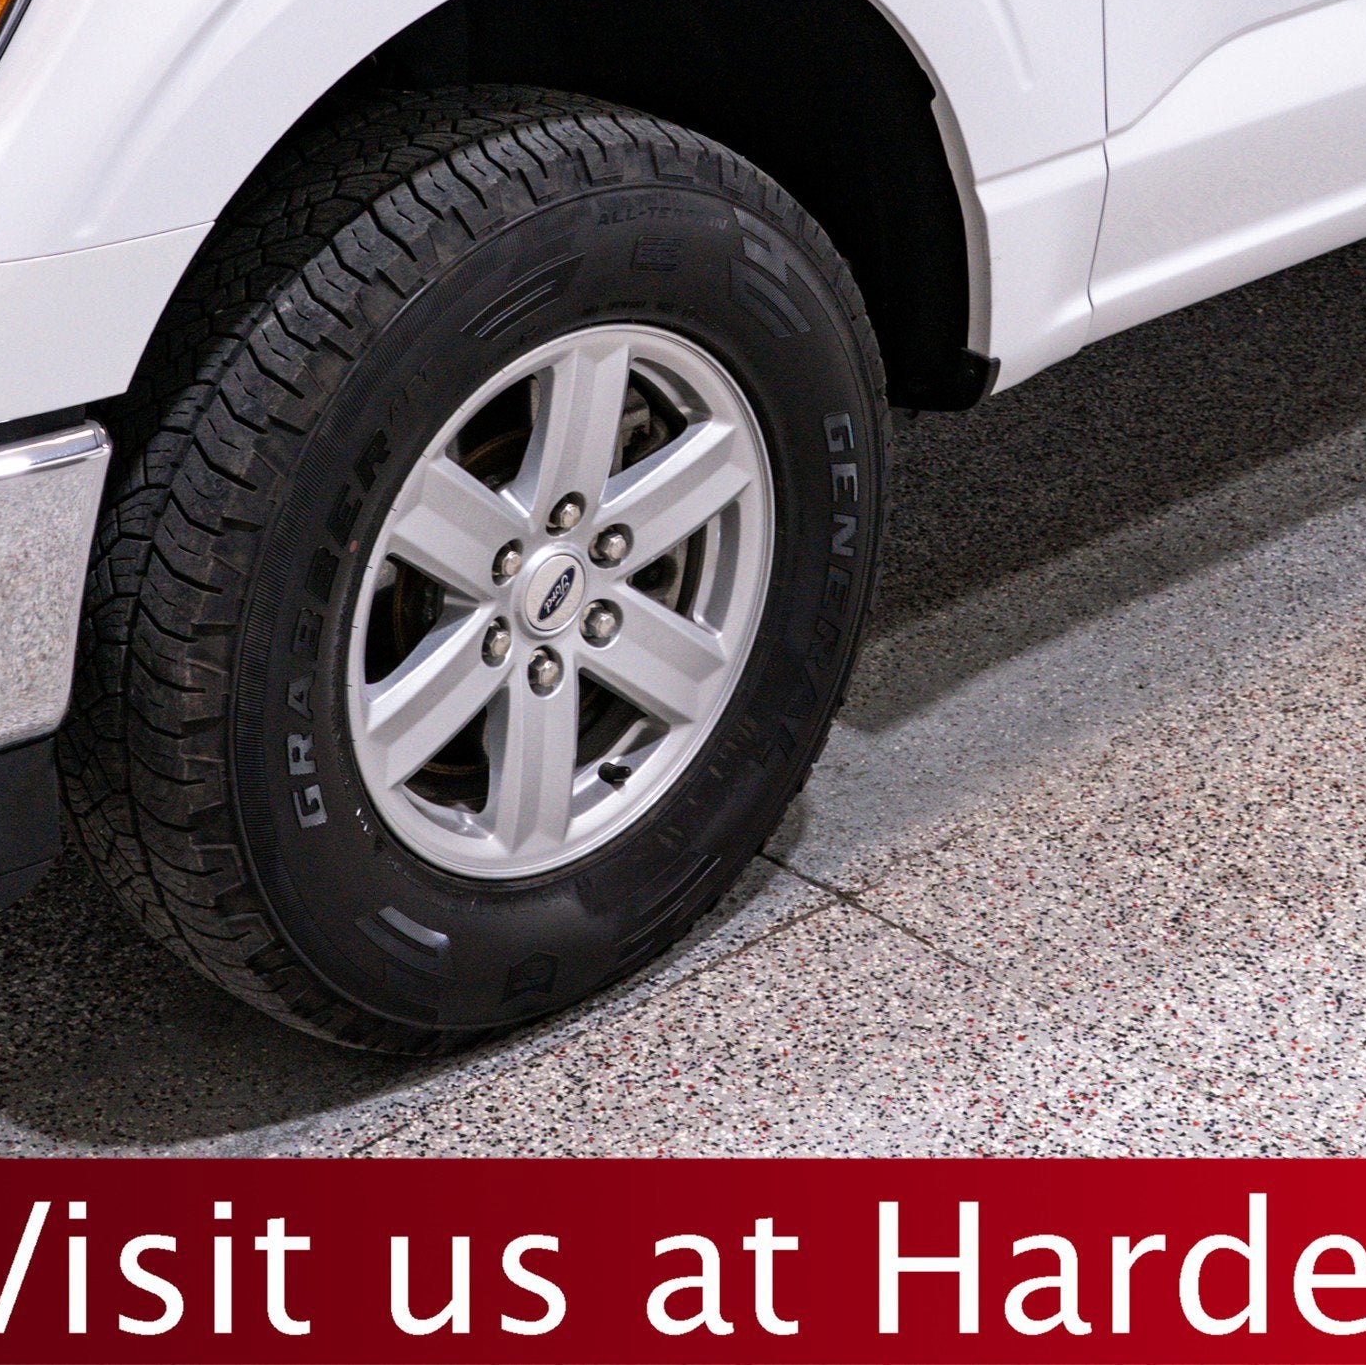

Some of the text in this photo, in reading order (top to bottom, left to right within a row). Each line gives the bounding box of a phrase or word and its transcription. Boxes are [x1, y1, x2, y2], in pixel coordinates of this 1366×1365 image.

[598, 206, 728, 231] ALL-TERIN
[286, 427, 391, 829] GRABBER
[759, 410, 861, 769] GENERAL
